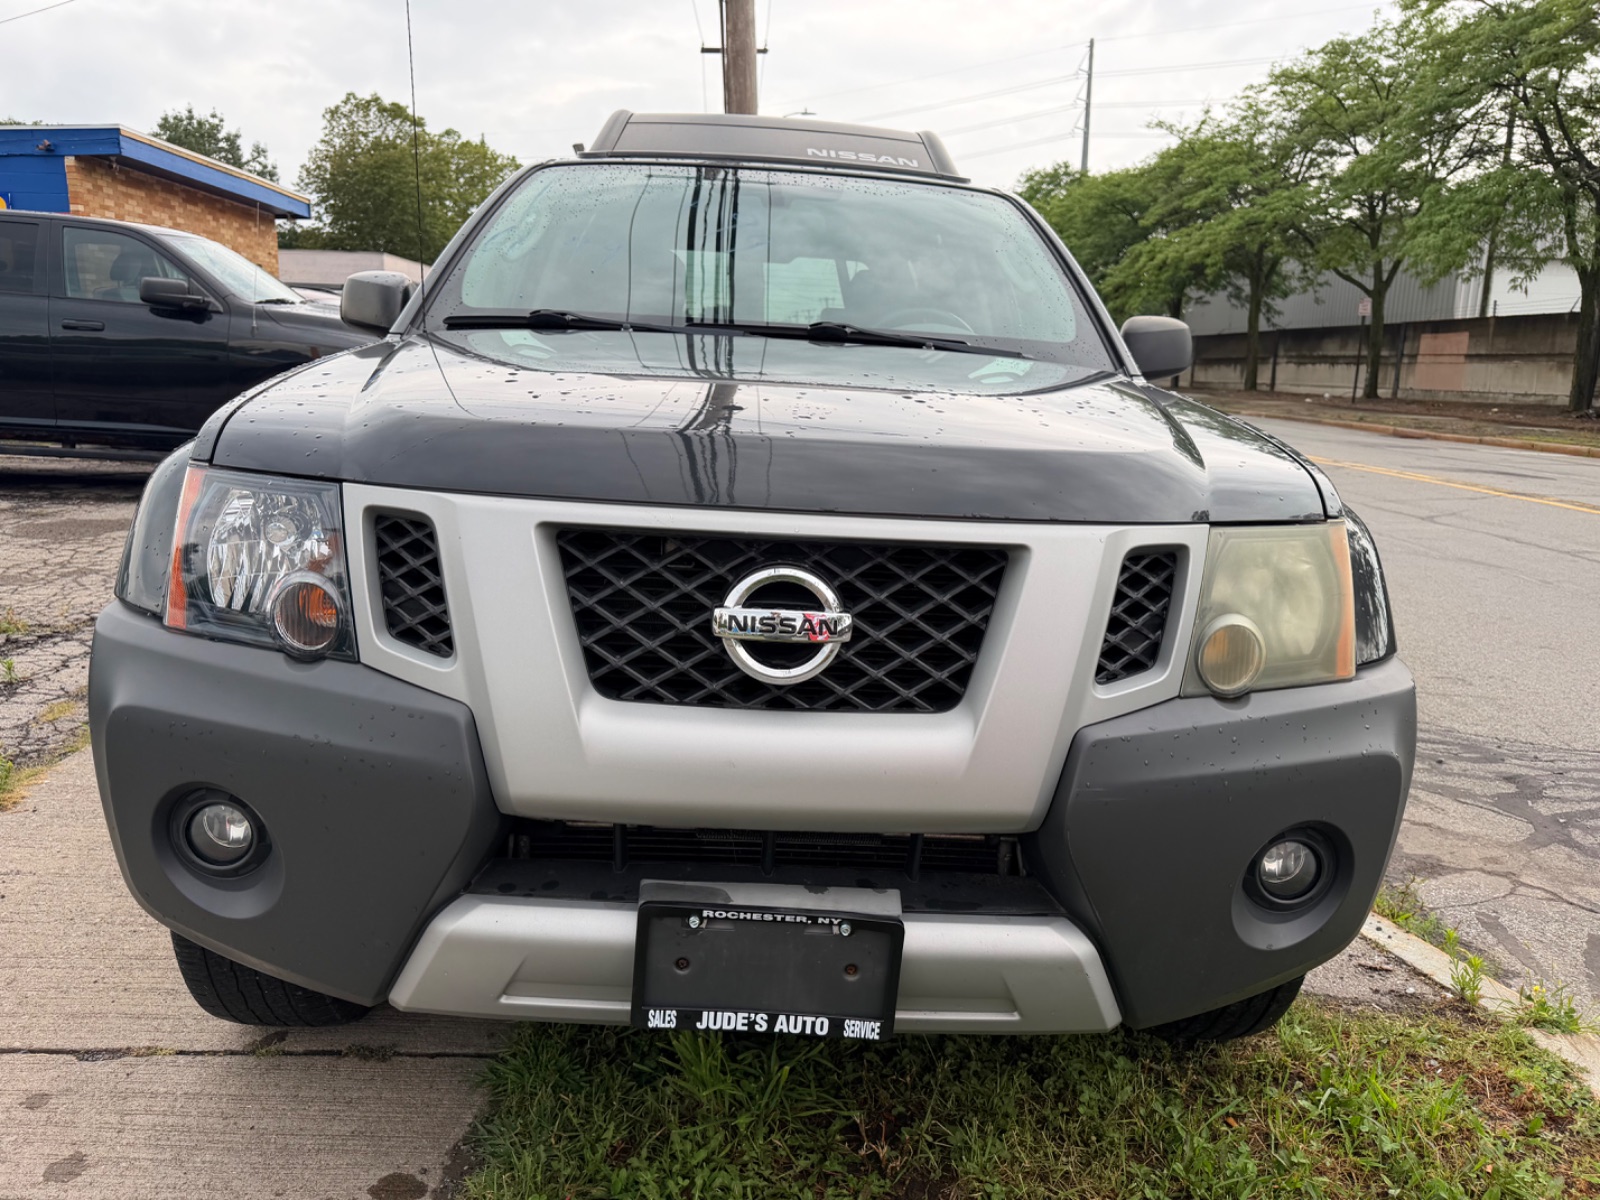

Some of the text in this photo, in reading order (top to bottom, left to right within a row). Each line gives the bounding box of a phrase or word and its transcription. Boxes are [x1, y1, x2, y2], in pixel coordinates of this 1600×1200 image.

[806, 148, 919, 168] NISSAN
[727, 614, 838, 636] NISSAN
[702, 909, 842, 925] ROCHESTER, NY
[647, 1009, 881, 1040] SALES JUDE'S AUTO SERVICE
